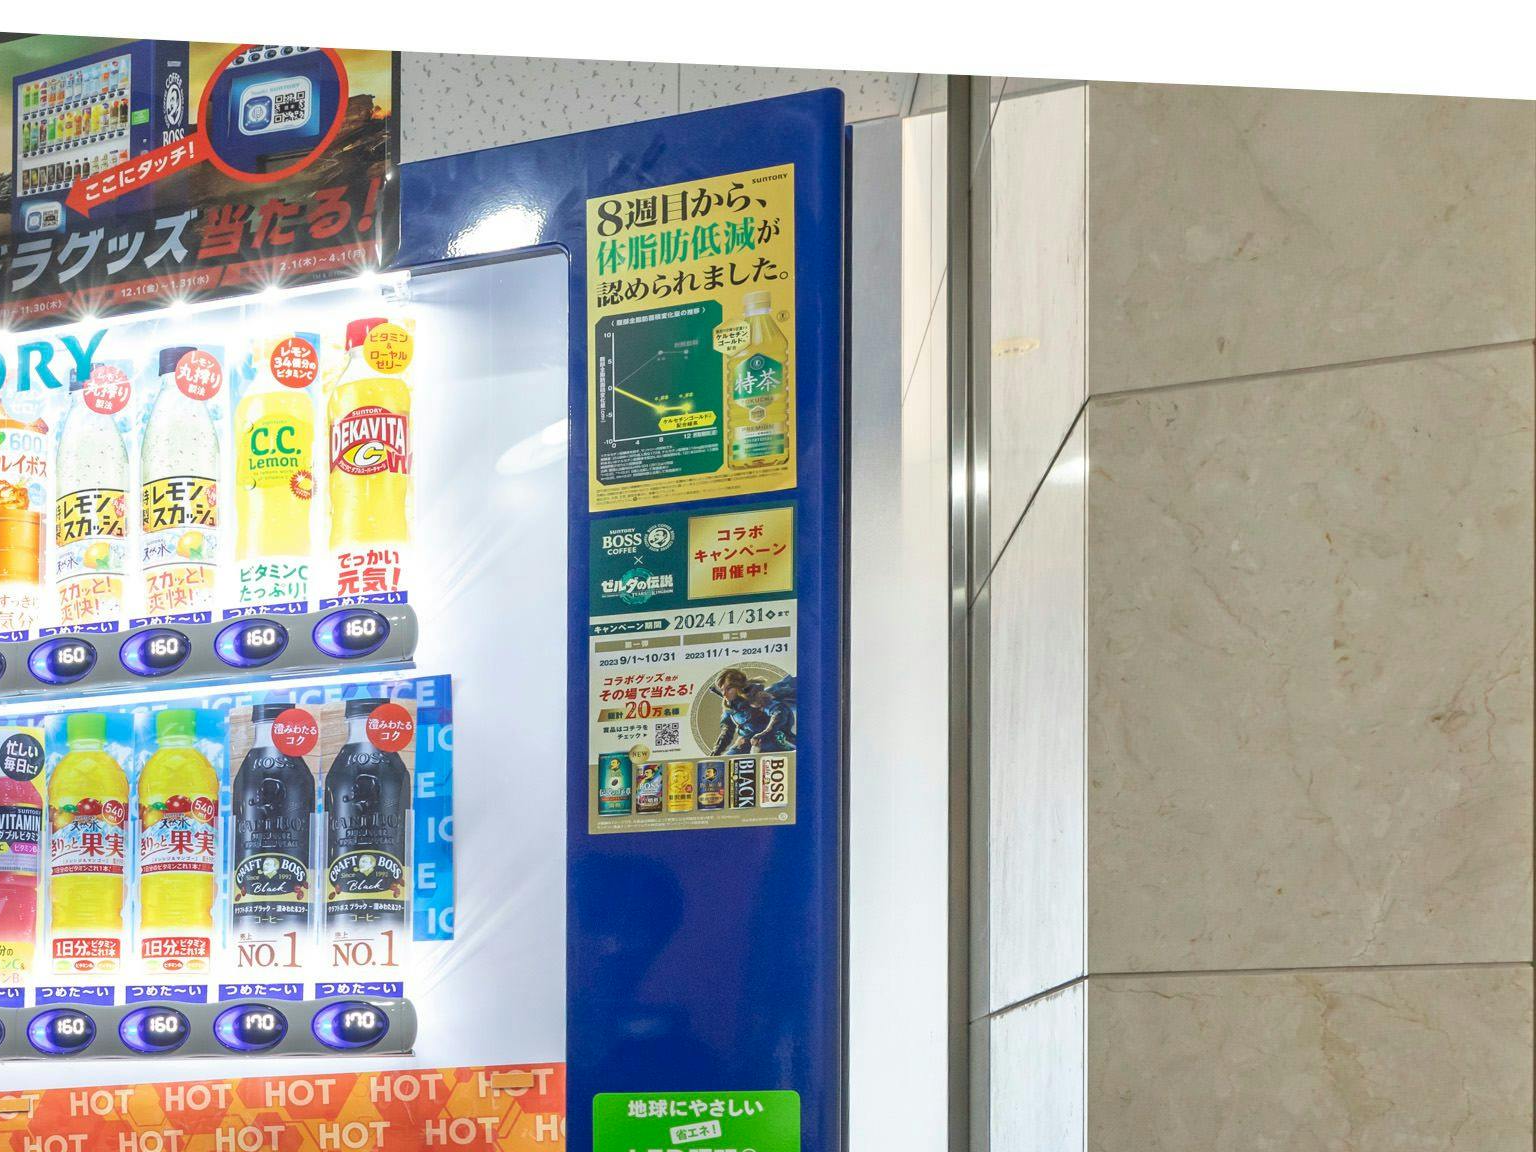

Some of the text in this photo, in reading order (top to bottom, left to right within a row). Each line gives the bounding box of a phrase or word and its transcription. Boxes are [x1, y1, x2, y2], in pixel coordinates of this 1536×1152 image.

[85, 141, 195, 201] ここにタッチ!
[751, 173, 788, 184] SUNTORY
[596, 181, 767, 237] 8週目から、
[596, 216, 780, 277] 体脂肪低減が
[596, 257, 789, 308] 認められました。
[369, 333, 408, 343] ビタミン
[280, 345, 311, 358] レモン
[370, 351, 407, 360] ローヤル
[276, 368, 313, 380] ビタミンC
[375, 360, 402, 369] ゼリー
[734, 367, 781, 395] 特茶
[251, 425, 302, 455] C.C.
[331, 415, 406, 462] DEKAVITA
[249, 455, 298, 471] Lemon
[152, 481, 204, 505] レモン
[64, 493, 111, 519] レモン
[64, 515, 124, 541] スカッシュ
[717, 525, 764, 542] コラボ
[602, 533, 642, 549] BOSS
[337, 549, 400, 569] でっかい
[608, 546, 637, 556] COFFEE
[694, 543, 787, 563] キャンペーン
[148, 566, 205, 593] スカッと!
[240, 564, 309, 583] ビタミンC
[712, 563, 768, 581] 開催中!
[59, 576, 112, 604] スカッと!
[337, 567, 401, 597] 元気!
[601, 573, 674, 593] ゼルダの伝説
[240, 582, 307, 603] たっぷり!
[594, 621, 662, 634] キャンペーン期間
[674, 607, 763, 631] 2024/1/31
[599, 684, 694, 701] その場で当たる!
[273, 723, 317, 736] 澄みわたる
[368, 717, 413, 731] 澄みわたる
[285, 735, 305, 746] コク
[380, 730, 400, 741] コク
[6, 740, 38, 757] 忙しい
[4, 756, 38, 775] 毎日に!
[738, 759, 755, 808] BLACK
[104, 803, 123, 818] 540
[194, 801, 213, 815] 540
[251, 882, 287, 893] Black
[346, 880, 384, 892] Black
[254, 916, 283, 924] コーヒー
[351, 914, 380, 922] コーヒー
[237, 931, 302, 968] NO.1
[332, 929, 399, 967] NO.1
[165, 1083, 231, 1112] HOT
[264, 1079, 336, 1108] HOT
[370, 1073, 443, 1103] HOT
[70, 1089, 134, 1117] HOT
[627, 1099, 764, 1118] 地球にやさしい
[319, 1121, 390, 1150] HOT
[425, 1116, 498, 1146] HOT
[675, 1124, 717, 1141] 省エネ!
